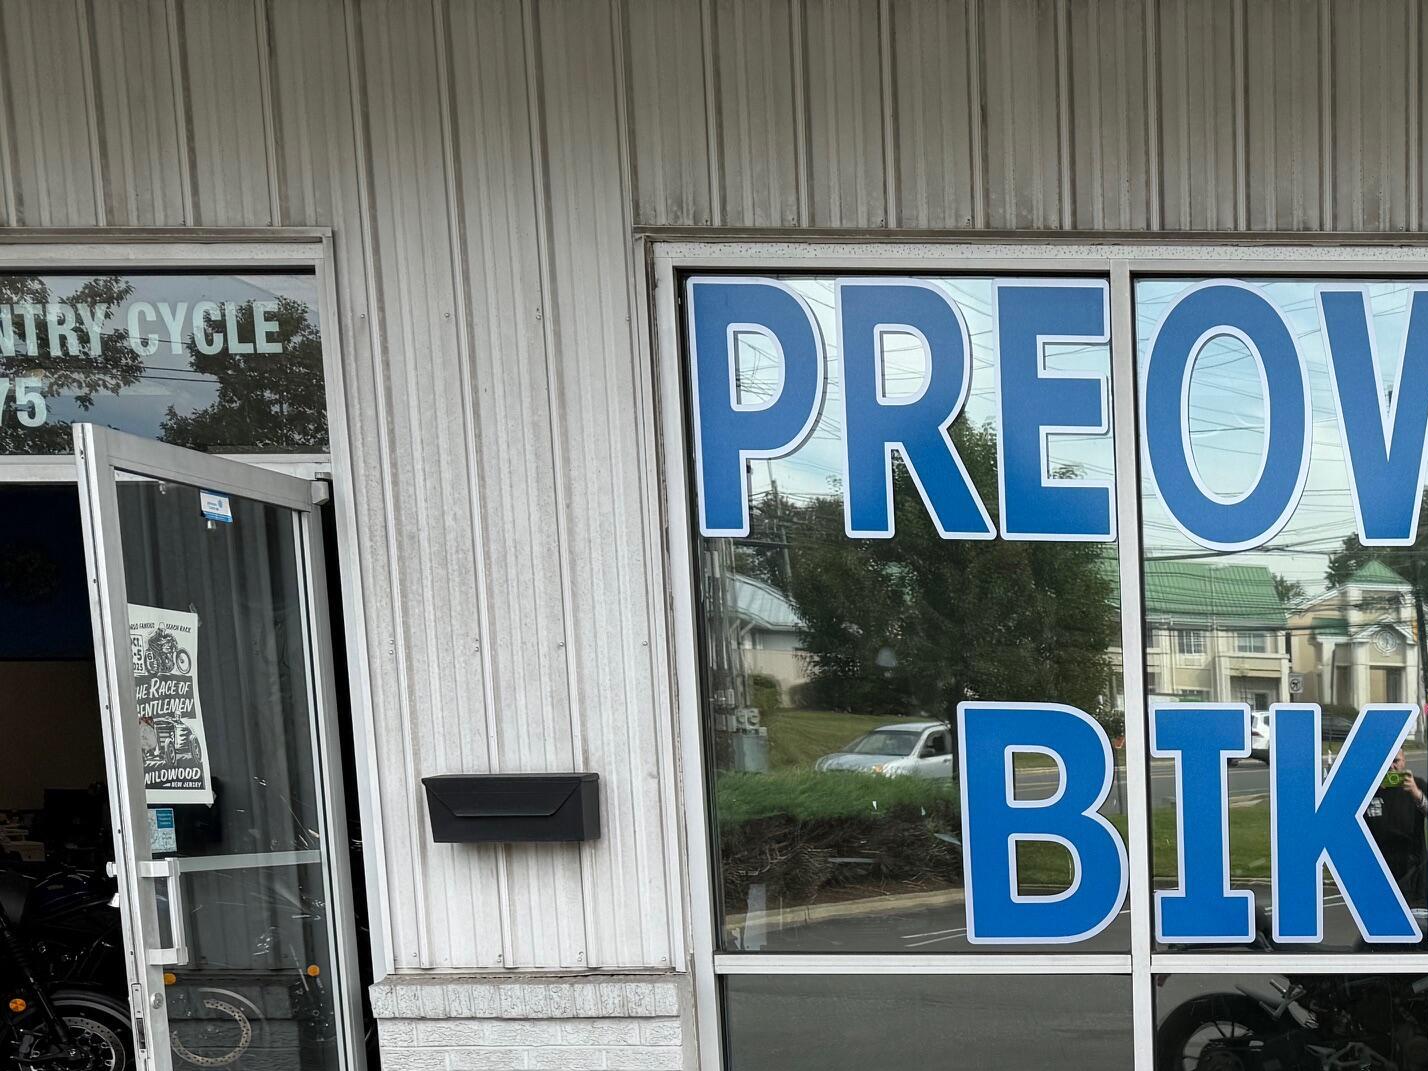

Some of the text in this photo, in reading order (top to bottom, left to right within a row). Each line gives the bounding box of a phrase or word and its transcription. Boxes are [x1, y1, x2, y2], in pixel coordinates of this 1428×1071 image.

[127, 301, 284, 355] CYCLE
[149, 677, 177, 698] RACE
[178, 681, 191, 695] OF
